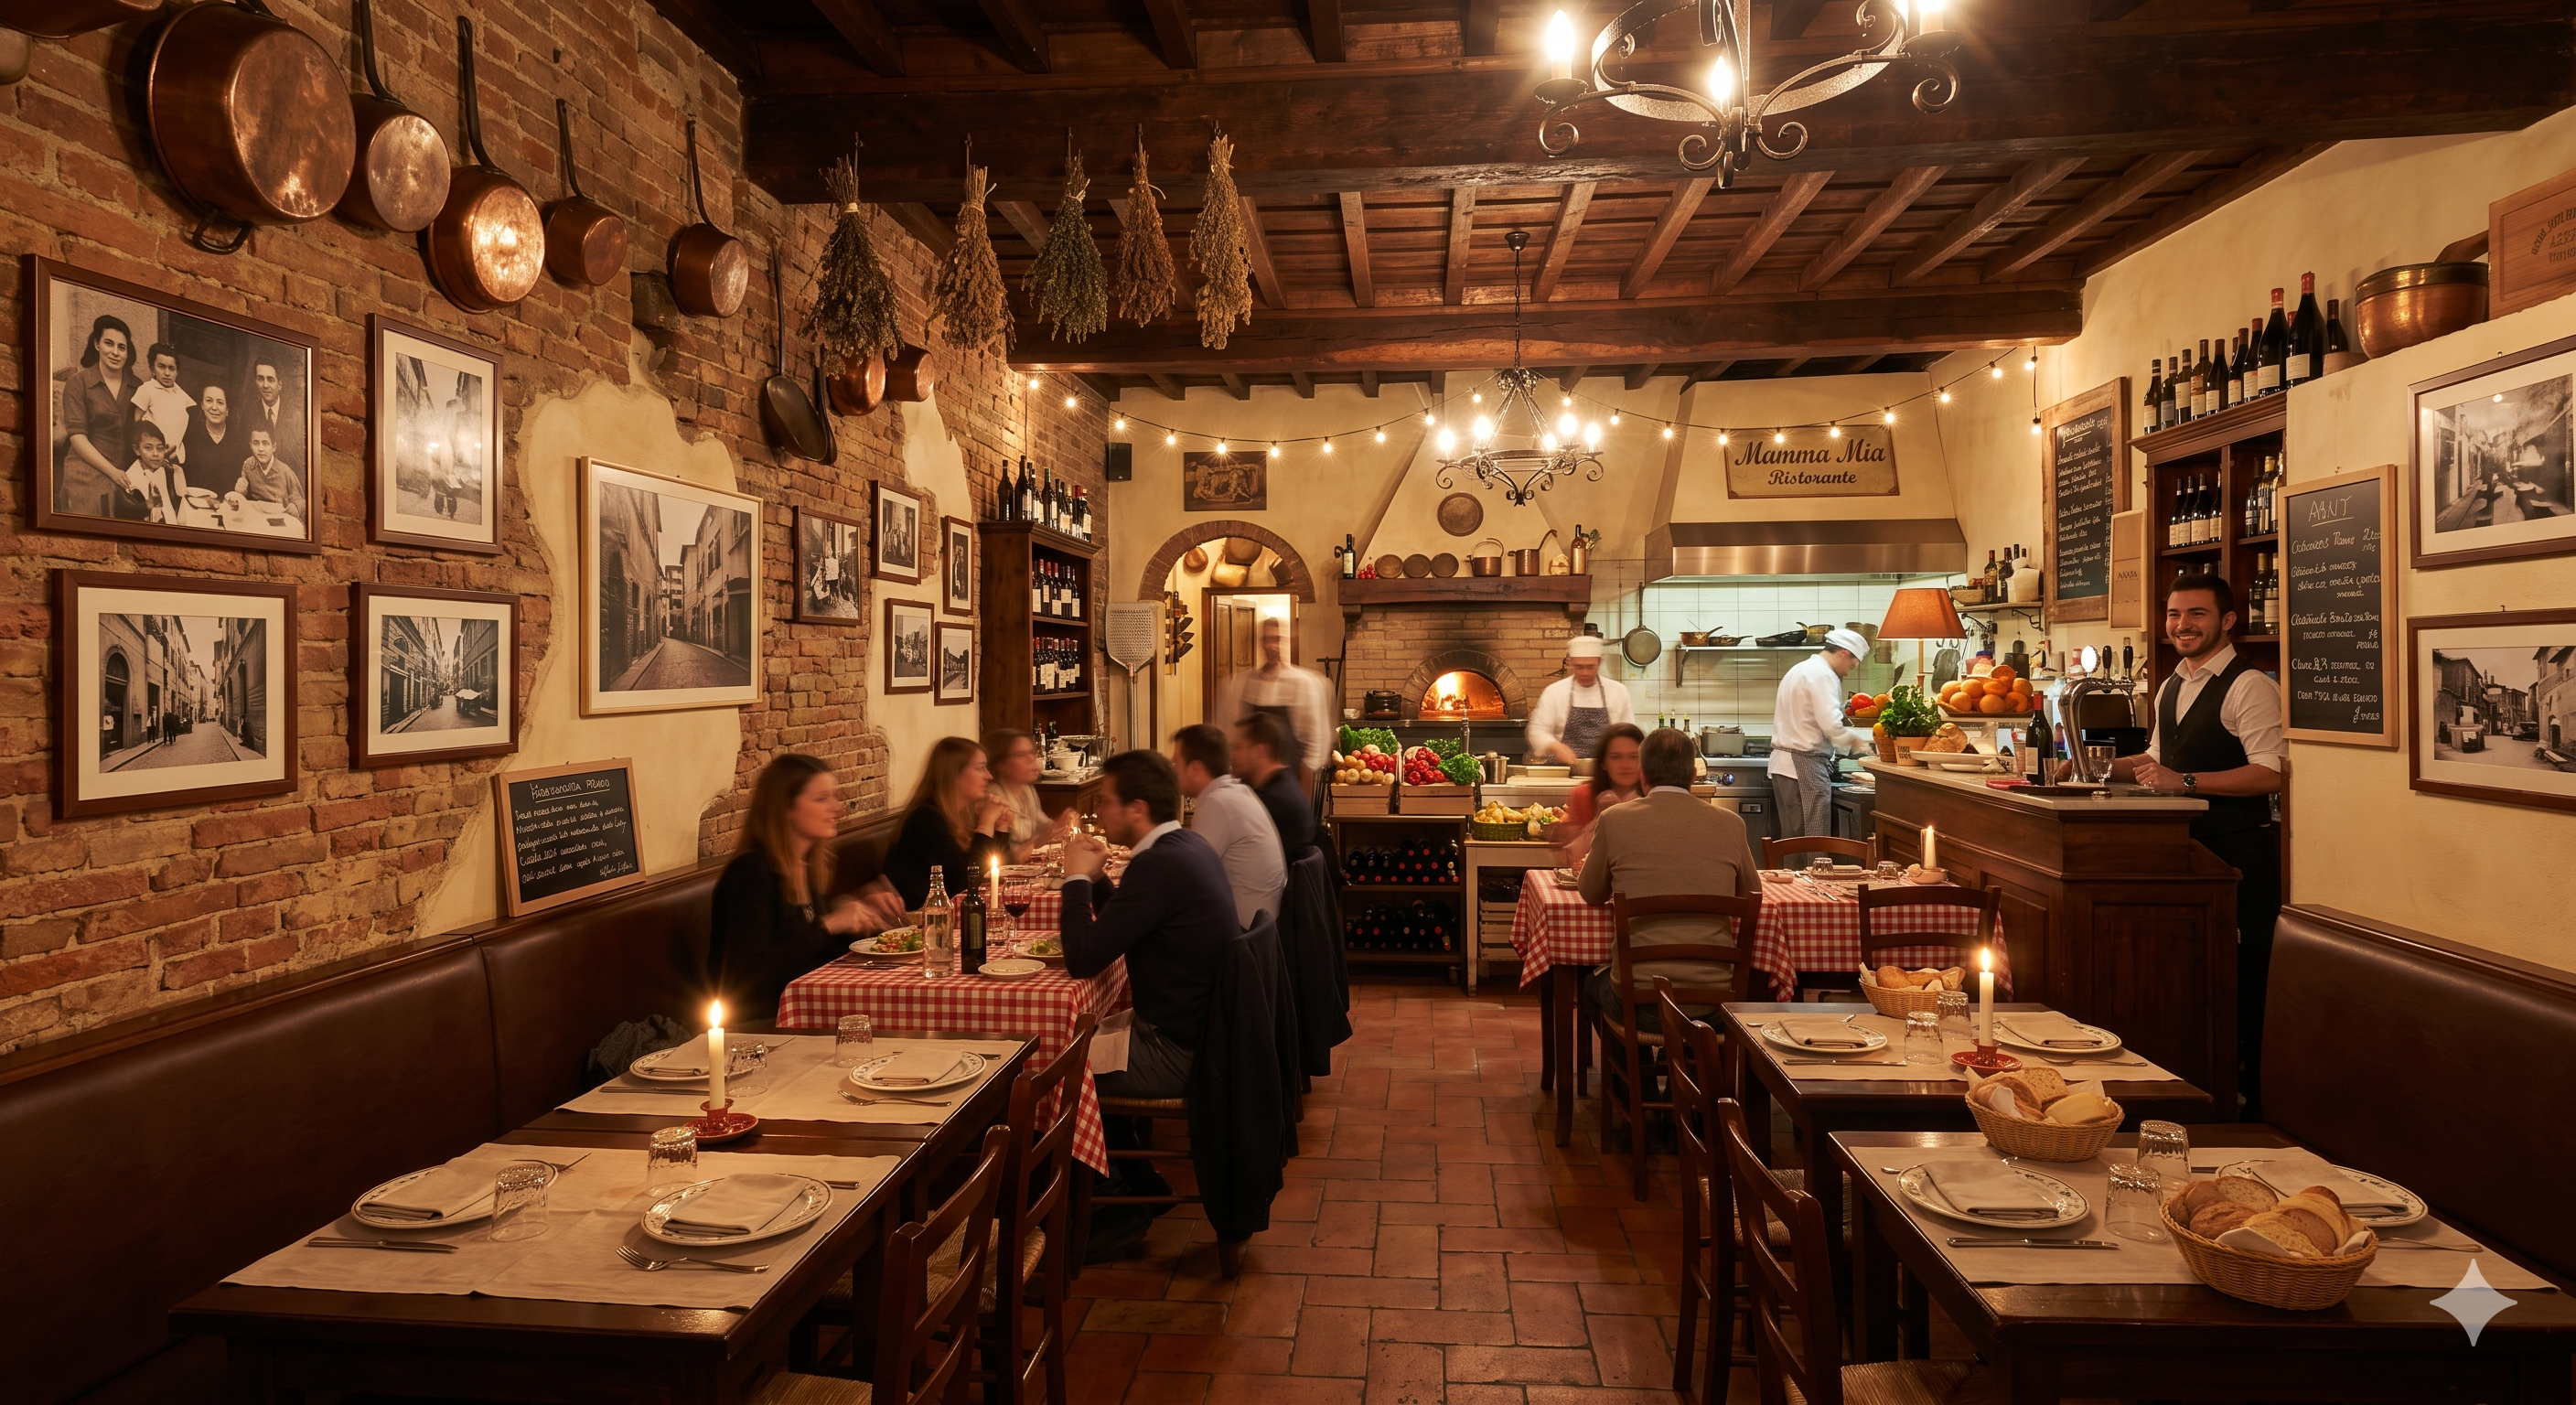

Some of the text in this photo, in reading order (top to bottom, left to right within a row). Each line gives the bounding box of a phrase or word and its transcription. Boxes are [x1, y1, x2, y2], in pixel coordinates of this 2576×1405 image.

[1734, 438, 1886, 467] Mamma Mia
[1767, 469, 1858, 486] Ristorante
